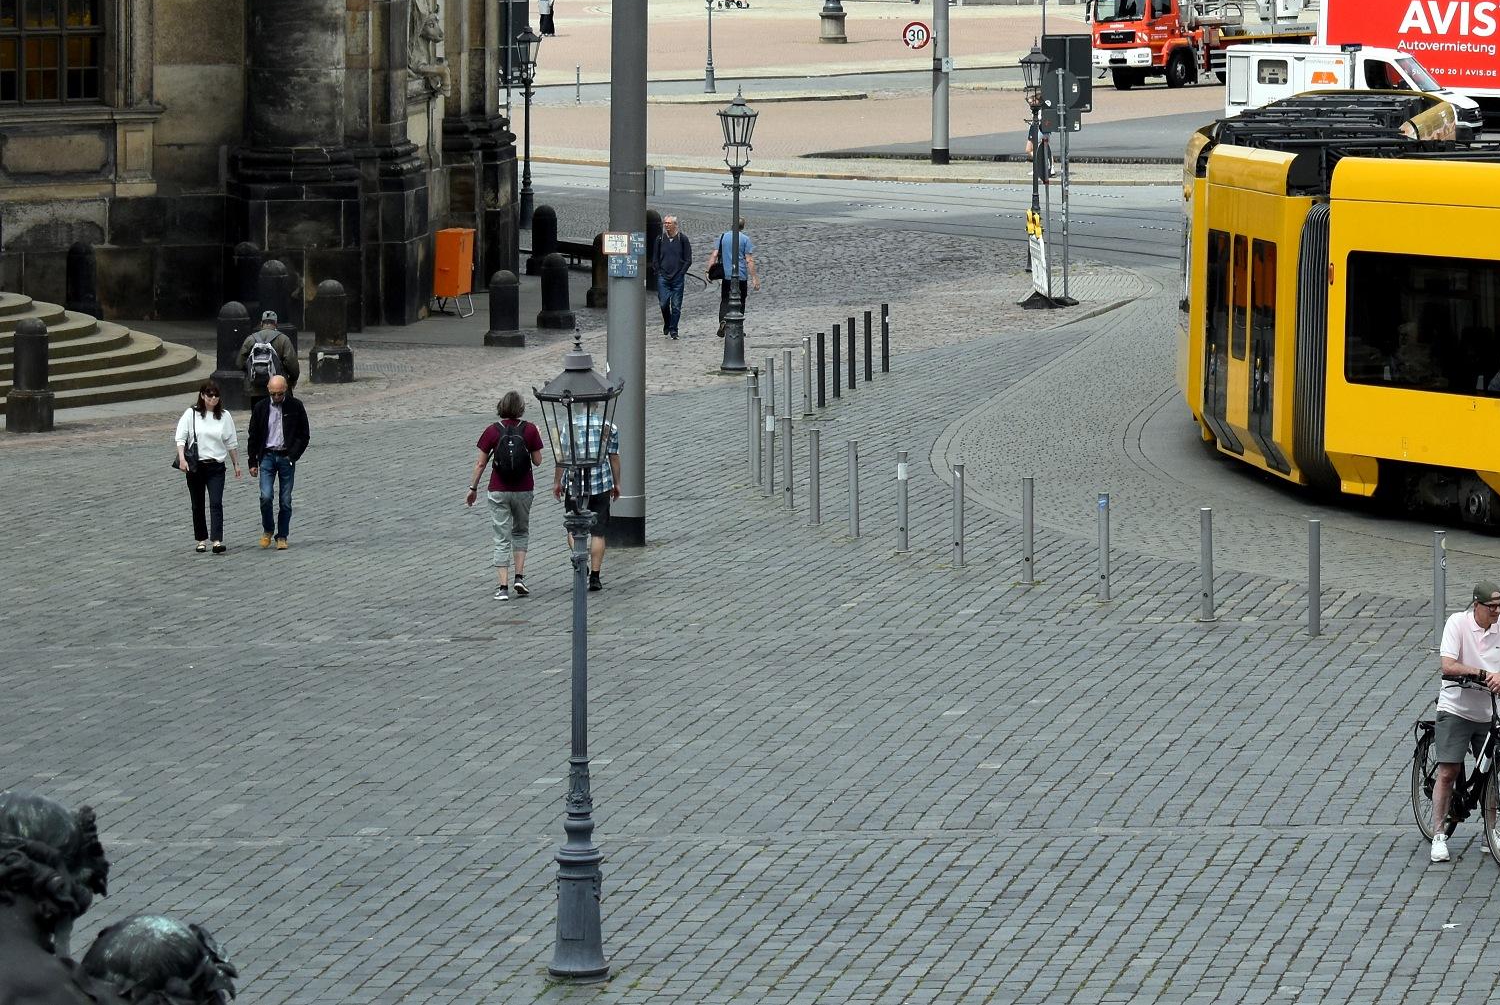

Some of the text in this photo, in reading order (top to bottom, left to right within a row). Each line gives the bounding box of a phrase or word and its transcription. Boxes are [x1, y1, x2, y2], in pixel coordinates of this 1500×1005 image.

[1398, 0, 1497, 37] AVIS
[908, 29, 924, 42] 30
[1397, 40, 1496, 56] Autovermietung
[1465, 69, 1497, 77] AVIS.DE
